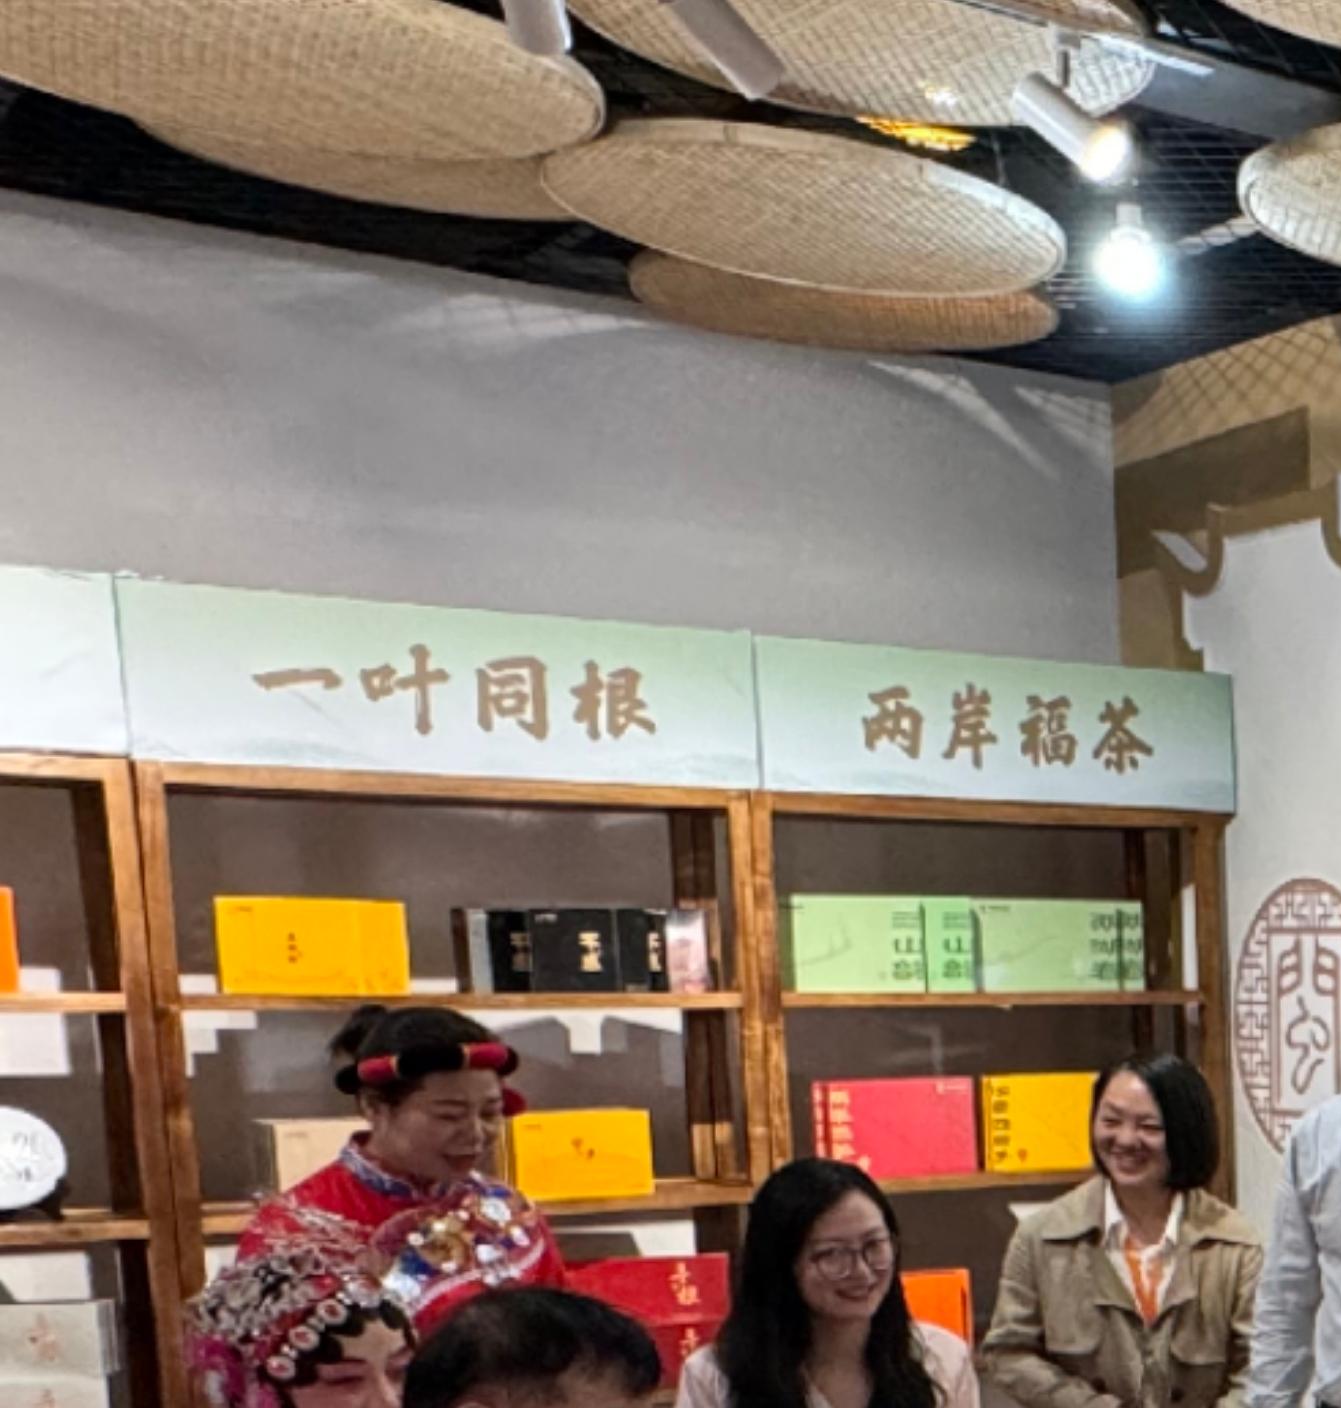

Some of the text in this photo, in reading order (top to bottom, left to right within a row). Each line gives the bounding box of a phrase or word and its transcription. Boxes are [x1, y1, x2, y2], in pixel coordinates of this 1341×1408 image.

[251, 643, 657, 741] 一叶同根
[861, 683, 1155, 774] 两岸福茶
